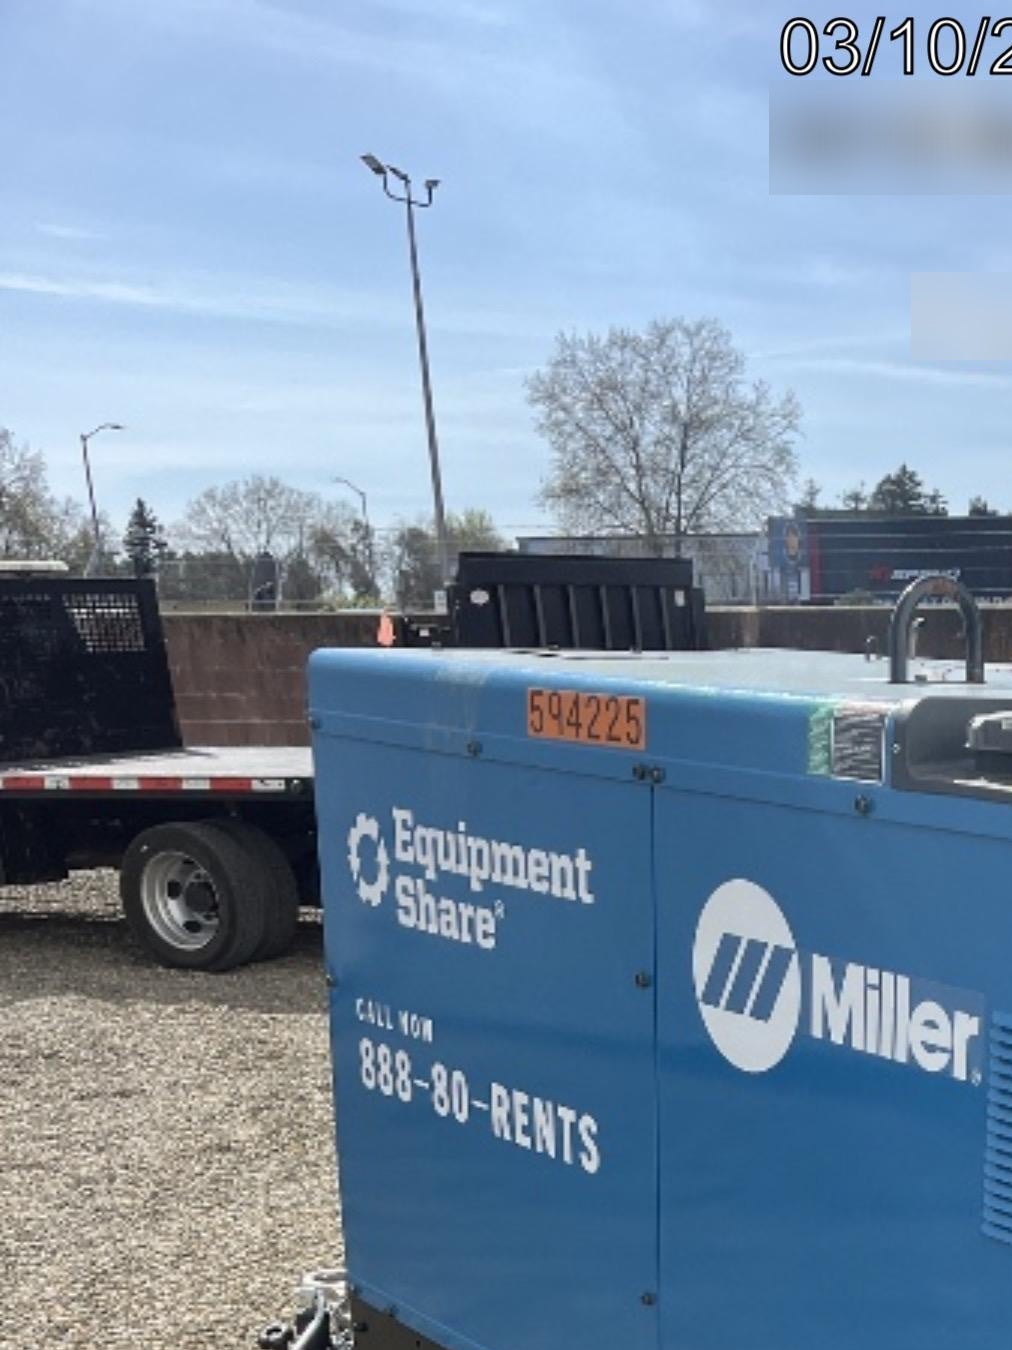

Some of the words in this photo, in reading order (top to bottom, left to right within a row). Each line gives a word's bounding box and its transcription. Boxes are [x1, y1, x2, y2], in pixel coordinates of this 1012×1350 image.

[529, 689, 641, 745] 594225
[392, 806, 595, 904] Equipment
[355, 997, 394, 1030] CALL
[398, 1010, 433, 1043] NOW
[810, 953, 980, 1082] Miller
[359, 1037, 601, 1175] 888-80-RENTS
